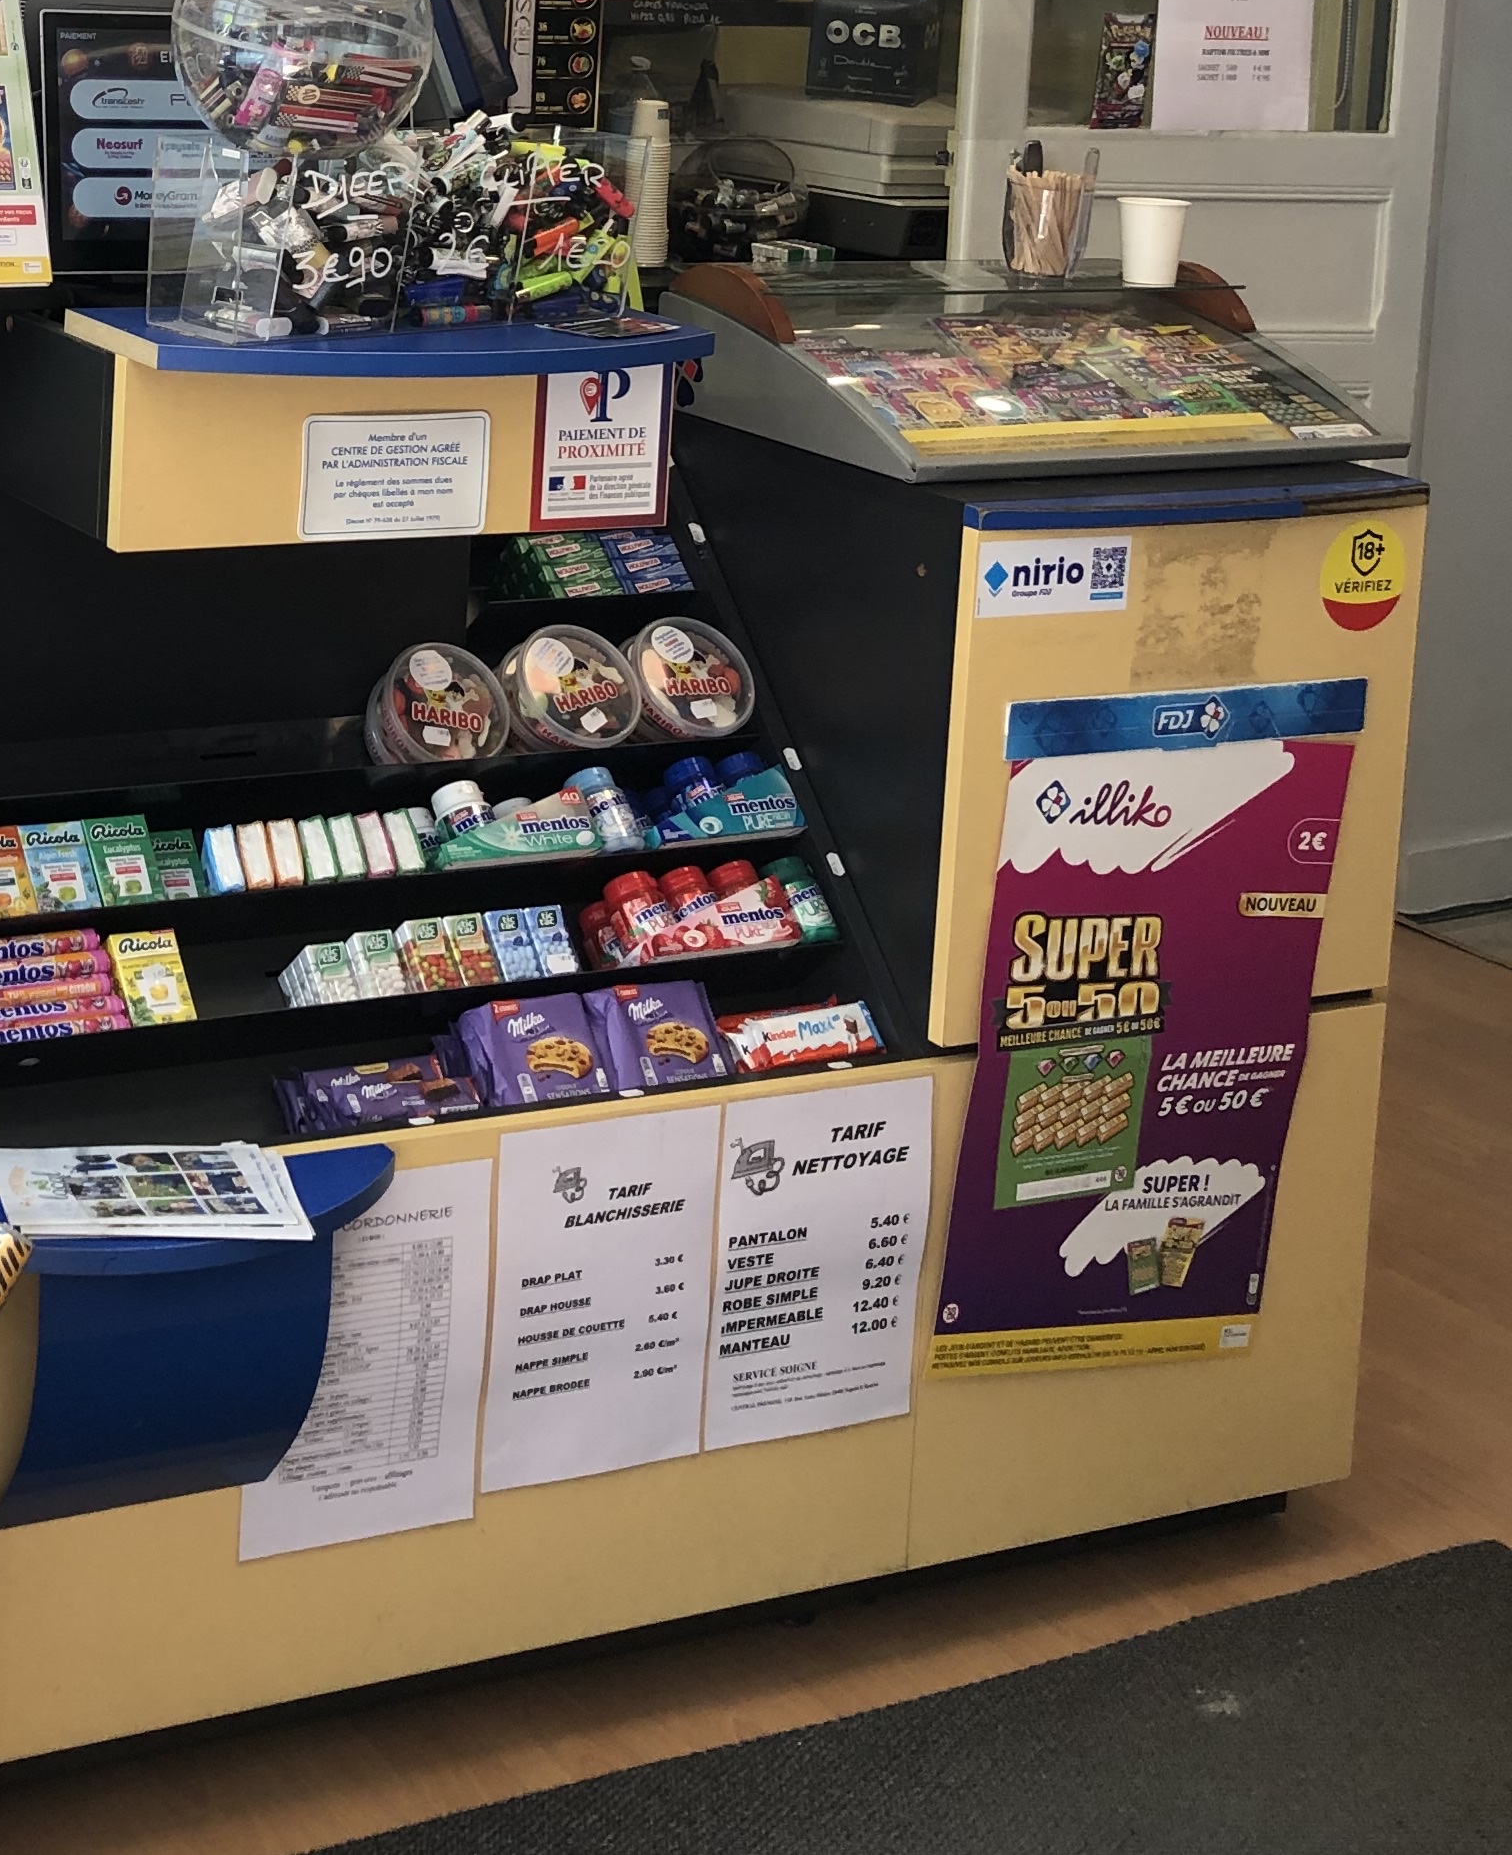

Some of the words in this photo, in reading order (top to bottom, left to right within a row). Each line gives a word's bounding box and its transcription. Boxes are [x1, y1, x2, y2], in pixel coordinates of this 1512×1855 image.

[59, 31, 97, 41] PAIEMENT
[825, 19, 903, 49] OCB
[1204, 25, 1263, 40] NOUVEAU
[96, 137, 144, 151] Neosurf
[134, 189, 198, 203] MoneyGram
[367, 432, 406, 443] Membre
[557, 427, 625, 442] PAIEMENT
[627, 426, 647, 439] DE
[331, 444, 367, 456] CENTRE
[369, 444, 384, 455] DE
[385, 444, 428, 455] GESTION
[430, 442, 461, 454] AGRÉÉ
[556, 440, 646, 460] PROXIMITÉ
[322, 459, 339, 469] PAR
[431, 455, 469, 467] FISCALE
[1356, 540, 1386, 561] 18+
[1011, 555, 1085, 587] nirio
[1333, 576, 1393, 595] VÉRIFIEZ
[411, 703, 483, 733] HARIBO
[1156, 708, 1194, 732] FDJ
[729, 797, 796, 815] mentos
[1069, 779, 1173, 828] illiko
[520, 815, 590, 836] mentos
[524, 831, 574, 846] White
[1297, 831, 1328, 852] 2€
[1245, 896, 1317, 913] NOUVEAU
[1010, 913, 1164, 983] SUPER
[506, 1013, 545, 1038] Milka
[1161, 1052, 1188, 1072] LA
[1189, 1044, 1296, 1070] MEILLEURE
[1156, 1069, 1239, 1093] CHANCE
[830, 1121, 887, 1144] TARIF
[792, 1145, 910, 1177] NETTOYAGE
[608, 1182, 653, 1201] TARIF
[1142, 1175, 1201, 1194] SUPER
[564, 1198, 686, 1229] BLANCHISSERIE
[1121, 1196, 1171, 1211] FAMILLE
[728, 1226, 808, 1249] PANTALON
[870, 1214, 900, 1229] 5.40
[727, 1252, 775, 1270] VESTE
[868, 1235, 898, 1250] 6.60
[521, 1274, 551, 1288] DRAP
[554, 1269, 583, 1283] PLAT
[725, 1275, 763, 1292] JUPE
[766, 1266, 820, 1286] DROITE
[865, 1255, 895, 1271] 6.40
[852, 1297, 889, 1314] 12.40
[719, 1333, 791, 1357] MANTEAU
[851, 1317, 888, 1335] 12.00
